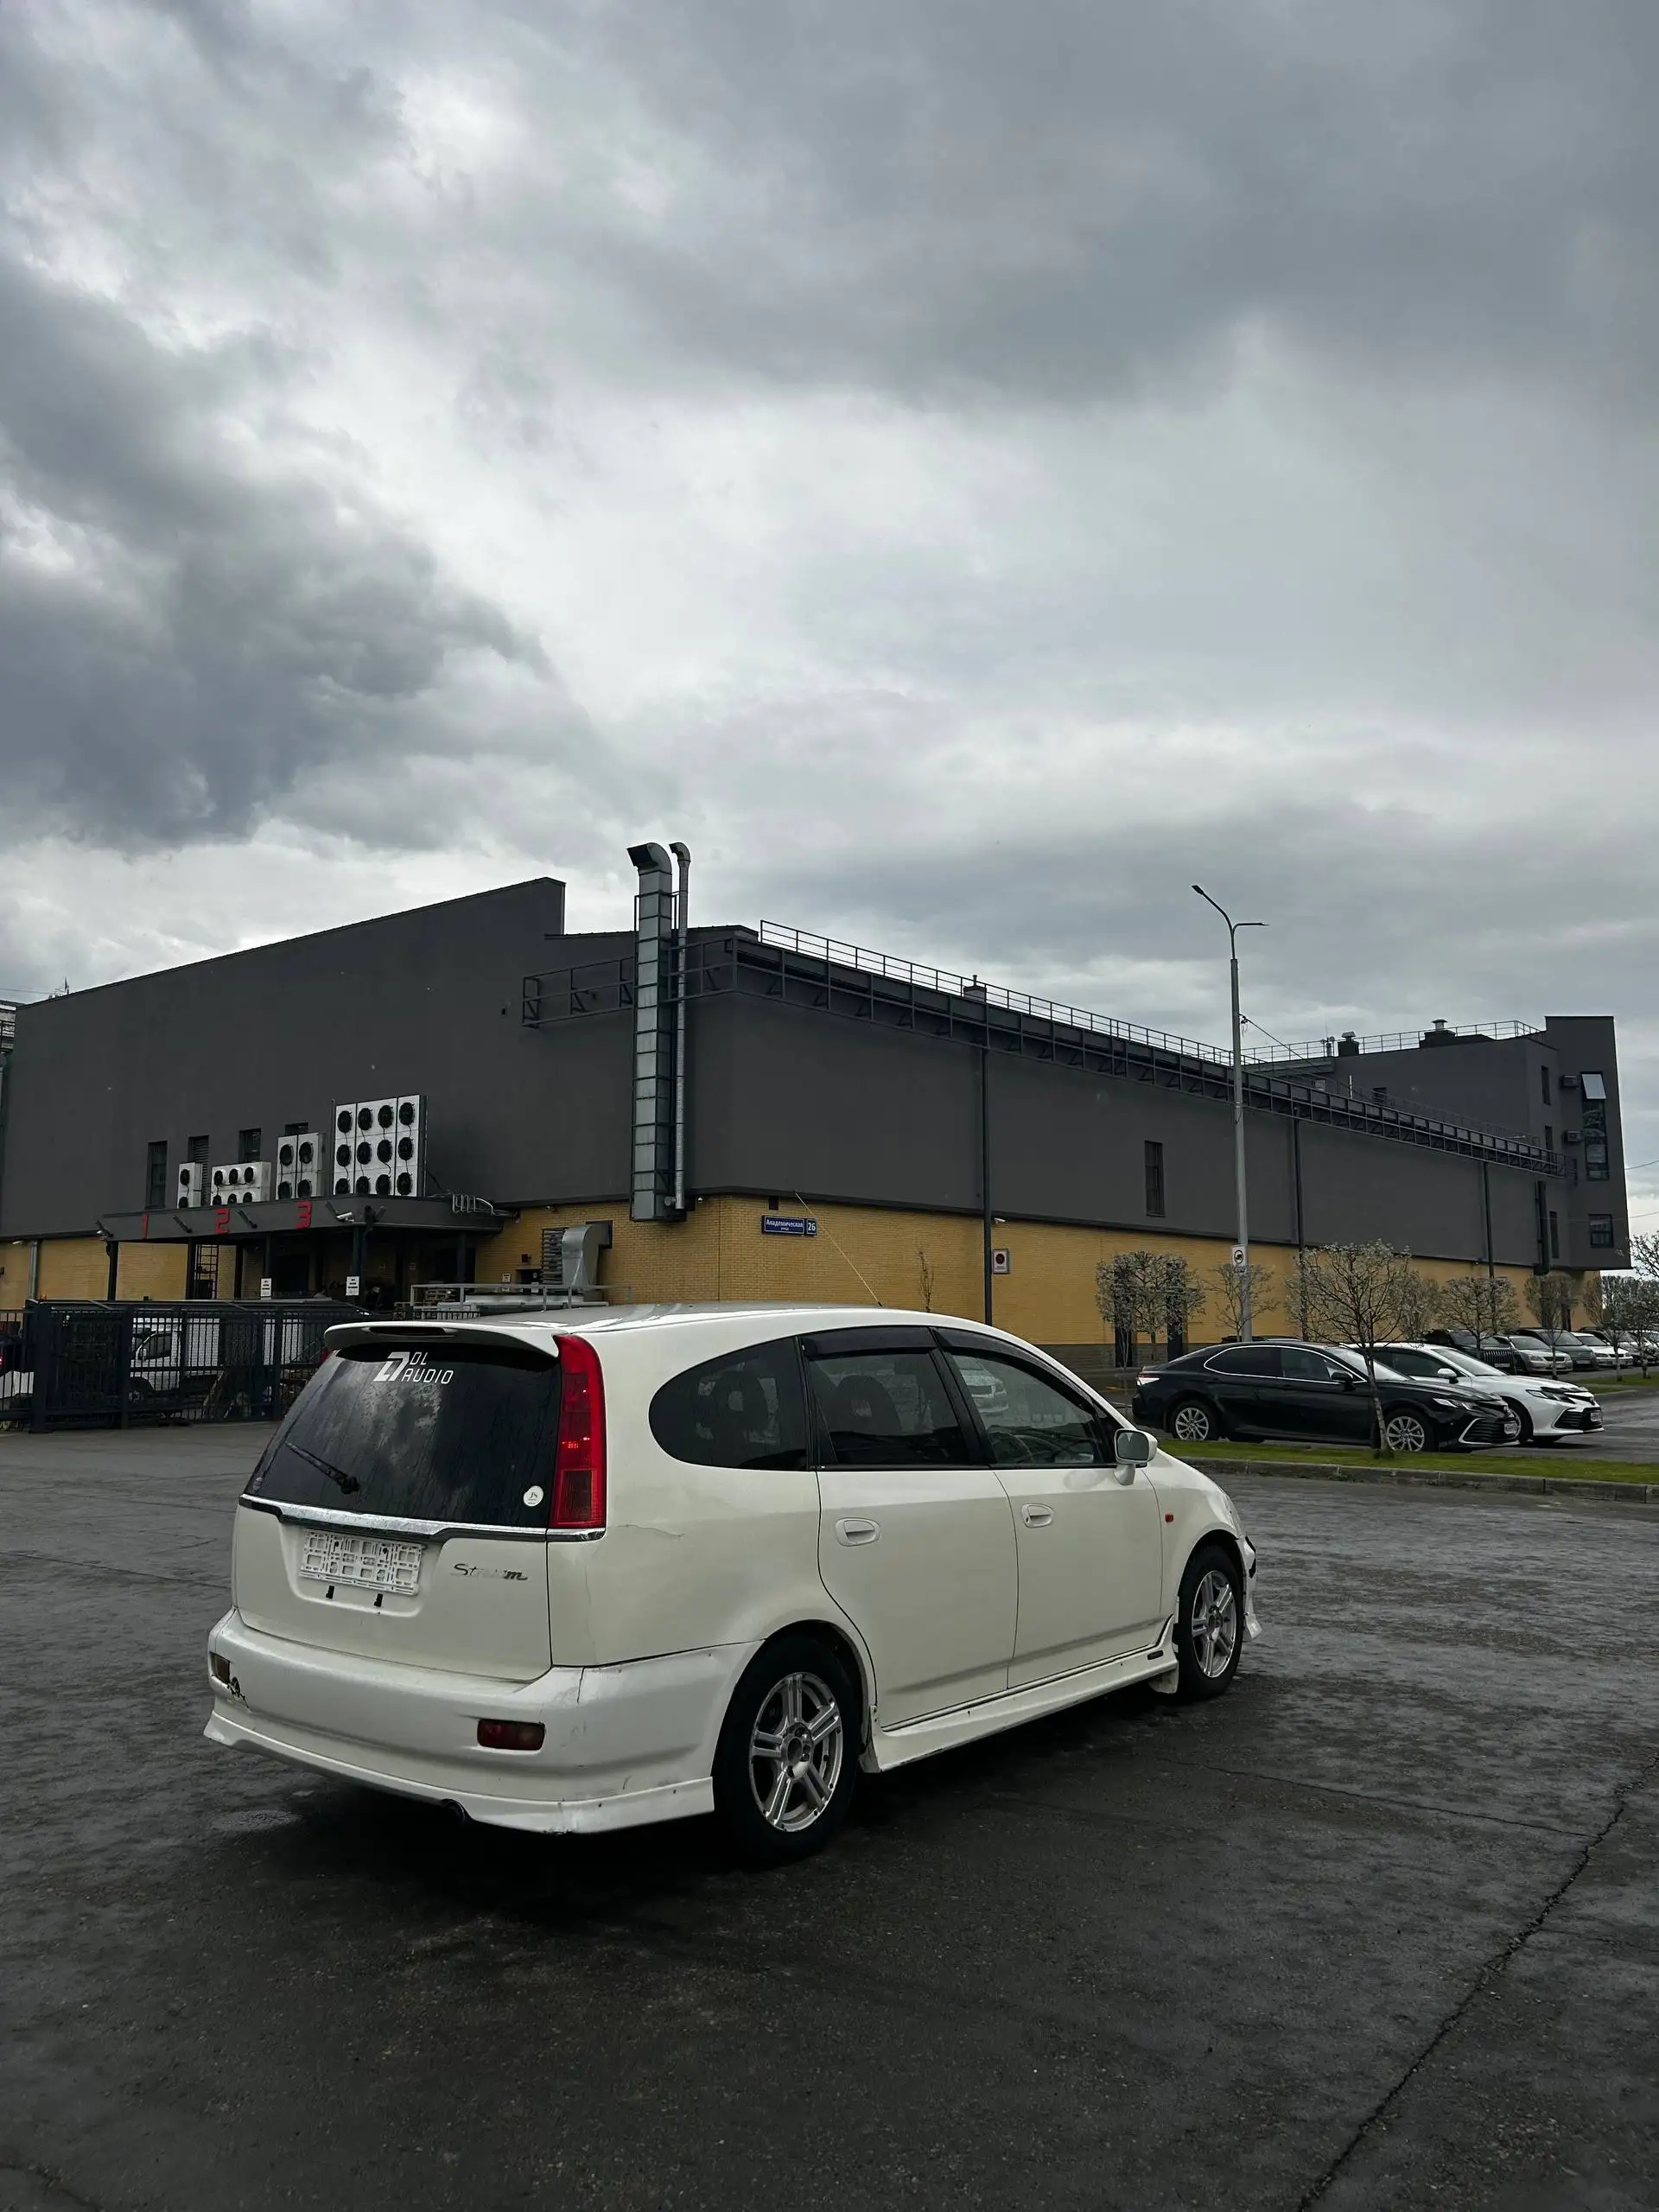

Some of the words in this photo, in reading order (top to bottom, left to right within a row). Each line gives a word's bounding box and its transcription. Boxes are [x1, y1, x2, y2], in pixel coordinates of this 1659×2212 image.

[215, 1208, 231, 1235] 2
[296, 1200, 313, 1229] 3
[143, 1212, 148, 1239] 1
[808, 1222, 816, 1231] 26
[410, 1351, 429, 1365] DL
[401, 1368, 454, 1384] AUDIO
